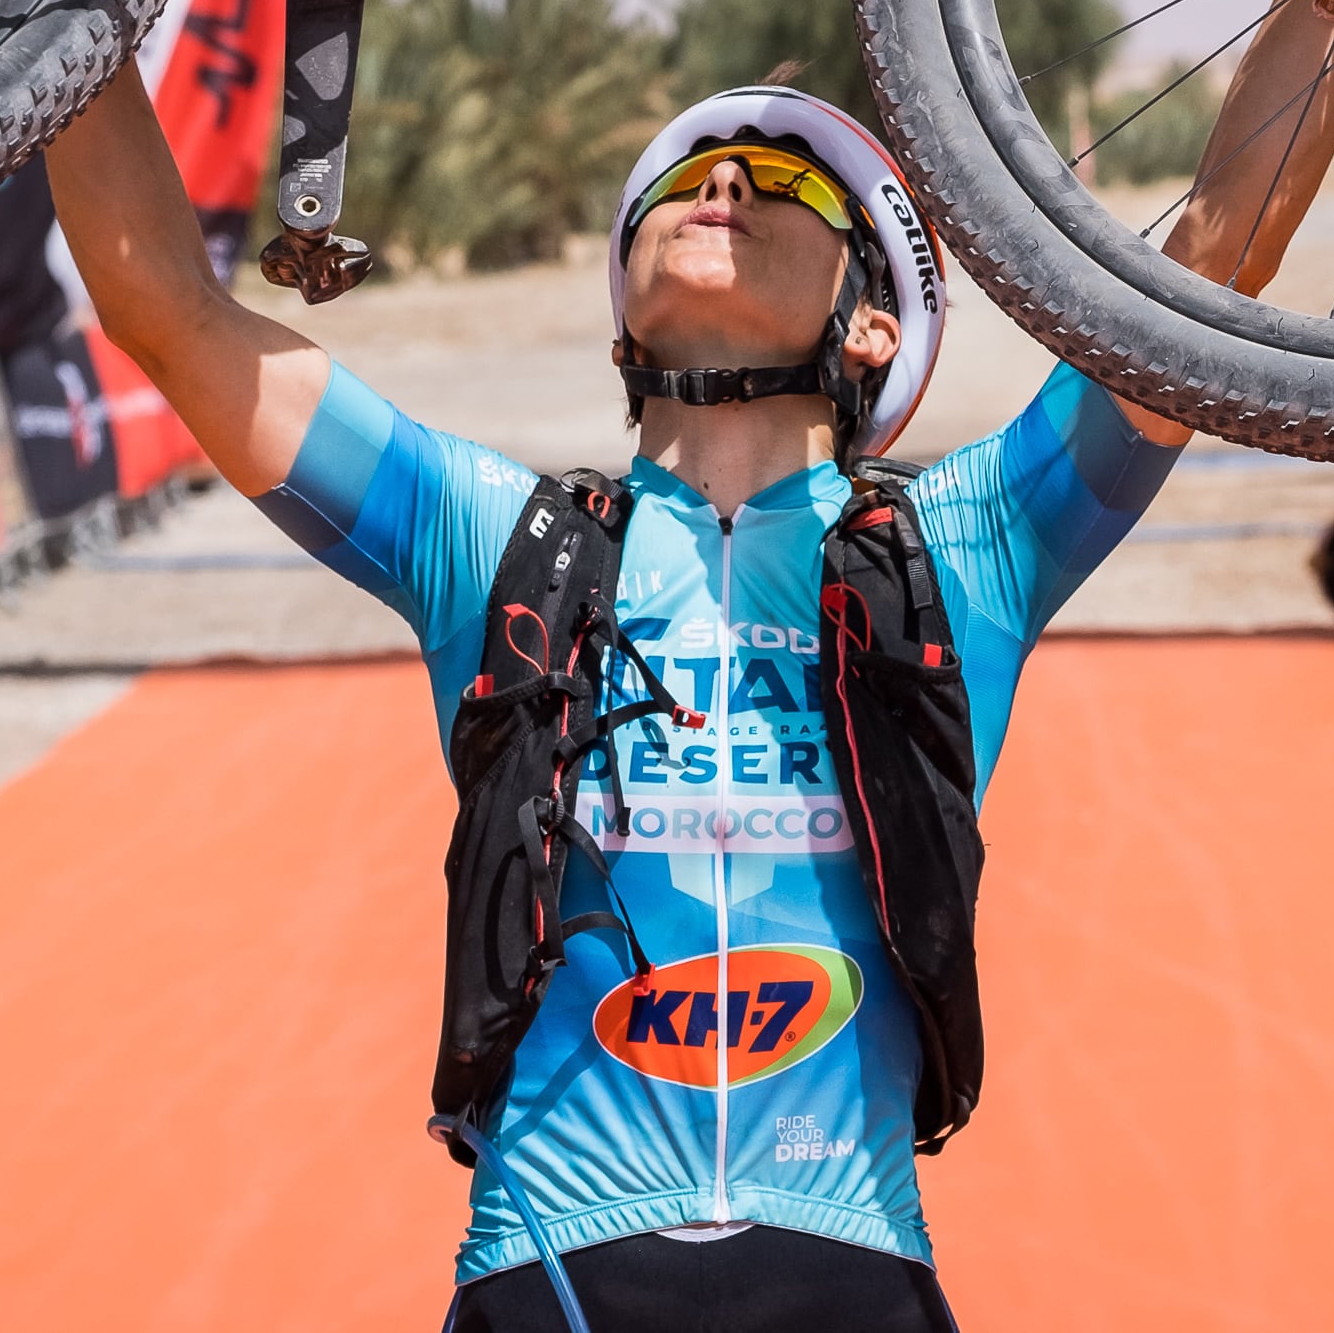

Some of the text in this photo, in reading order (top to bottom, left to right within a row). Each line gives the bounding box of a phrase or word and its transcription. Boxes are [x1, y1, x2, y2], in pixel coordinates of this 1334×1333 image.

[680, 618, 822, 655] ŠKOD
[577, 738, 835, 786] DESER
[591, 805, 844, 841] MOROCCO
[775, 1114, 816, 1132] RIDE
[776, 1128, 825, 1144] YOUR
[774, 1138, 856, 1163] DREAM
